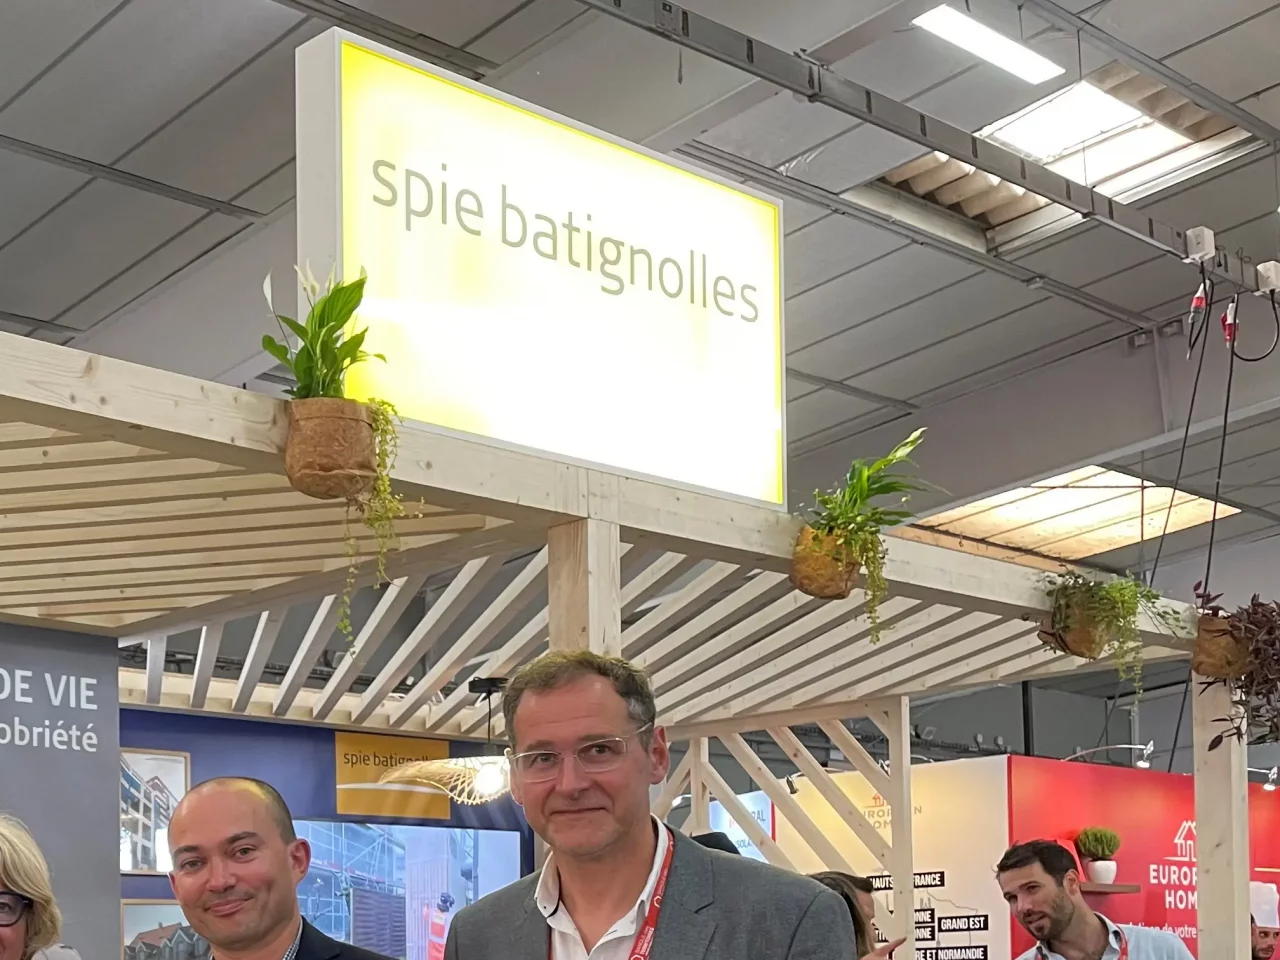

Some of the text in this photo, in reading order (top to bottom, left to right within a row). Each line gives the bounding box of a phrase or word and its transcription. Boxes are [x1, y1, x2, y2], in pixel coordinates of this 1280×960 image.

[372, 159, 760, 324] spie batignolles
[44, 672, 98, 711] VIE
[343, 750, 371, 768] spie
[914, 873, 941, 887] RANCE
[941, 916, 985, 931] GRAND EST
[926, 949, 937, 960] ET
[937, 947, 985, 960] NORMANDIE
